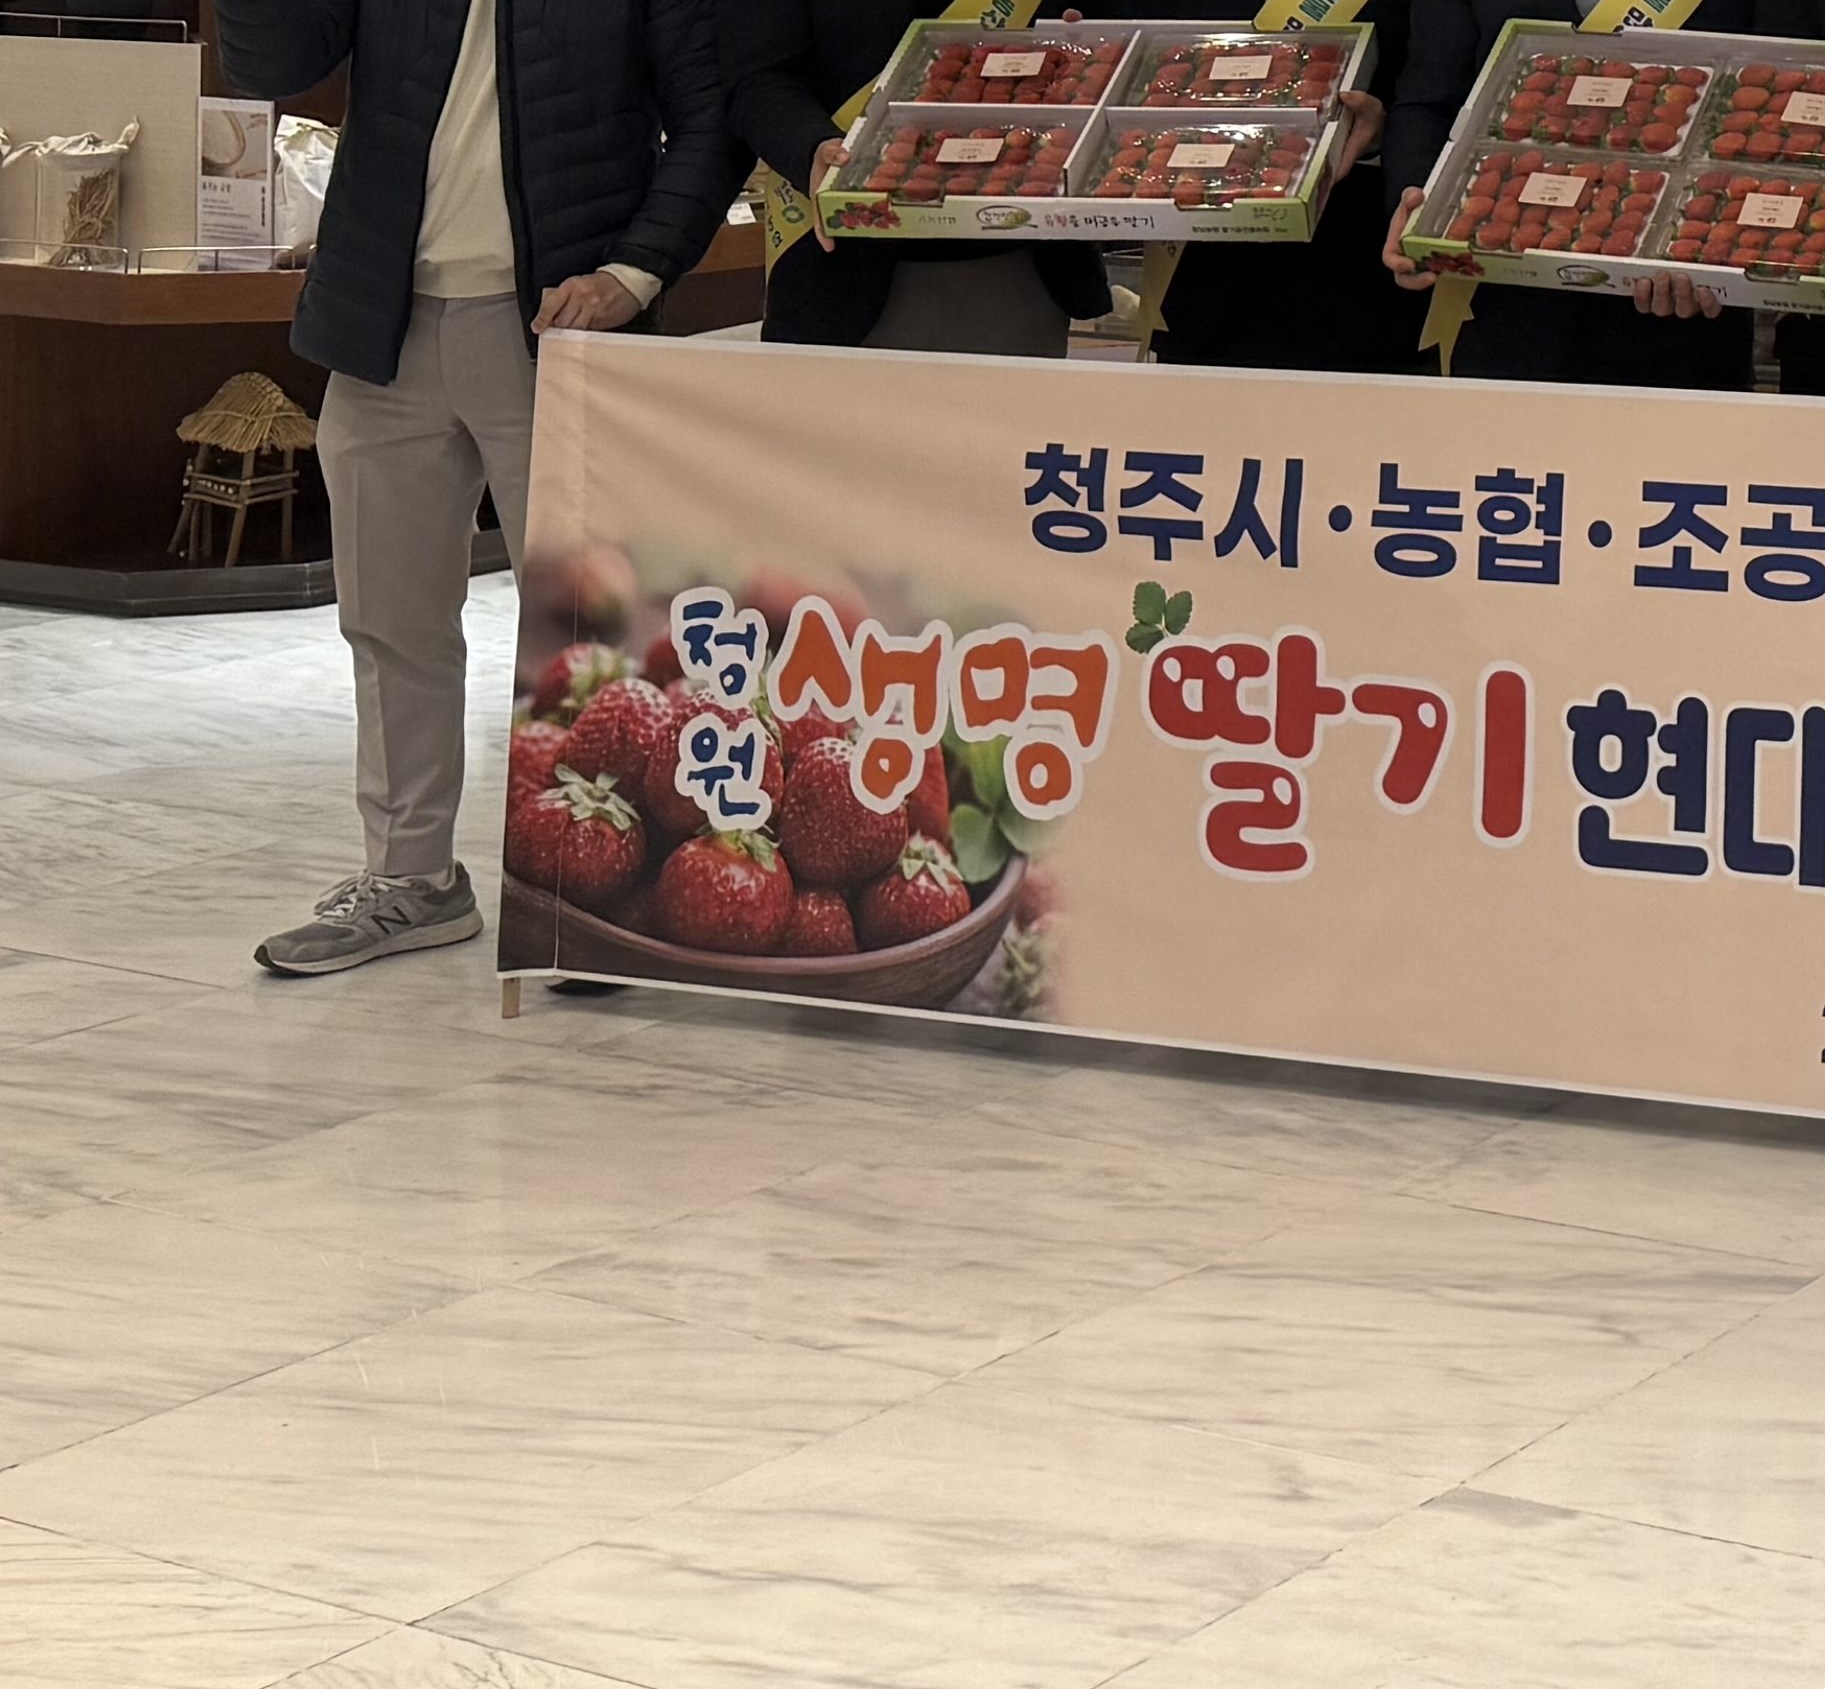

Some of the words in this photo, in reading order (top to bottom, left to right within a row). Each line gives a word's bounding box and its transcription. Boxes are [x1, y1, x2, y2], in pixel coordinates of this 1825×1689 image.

[680, 596, 766, 818] 청원
[776, 606, 1112, 809] 생명
[1146, 632, 1530, 874] 딸기
